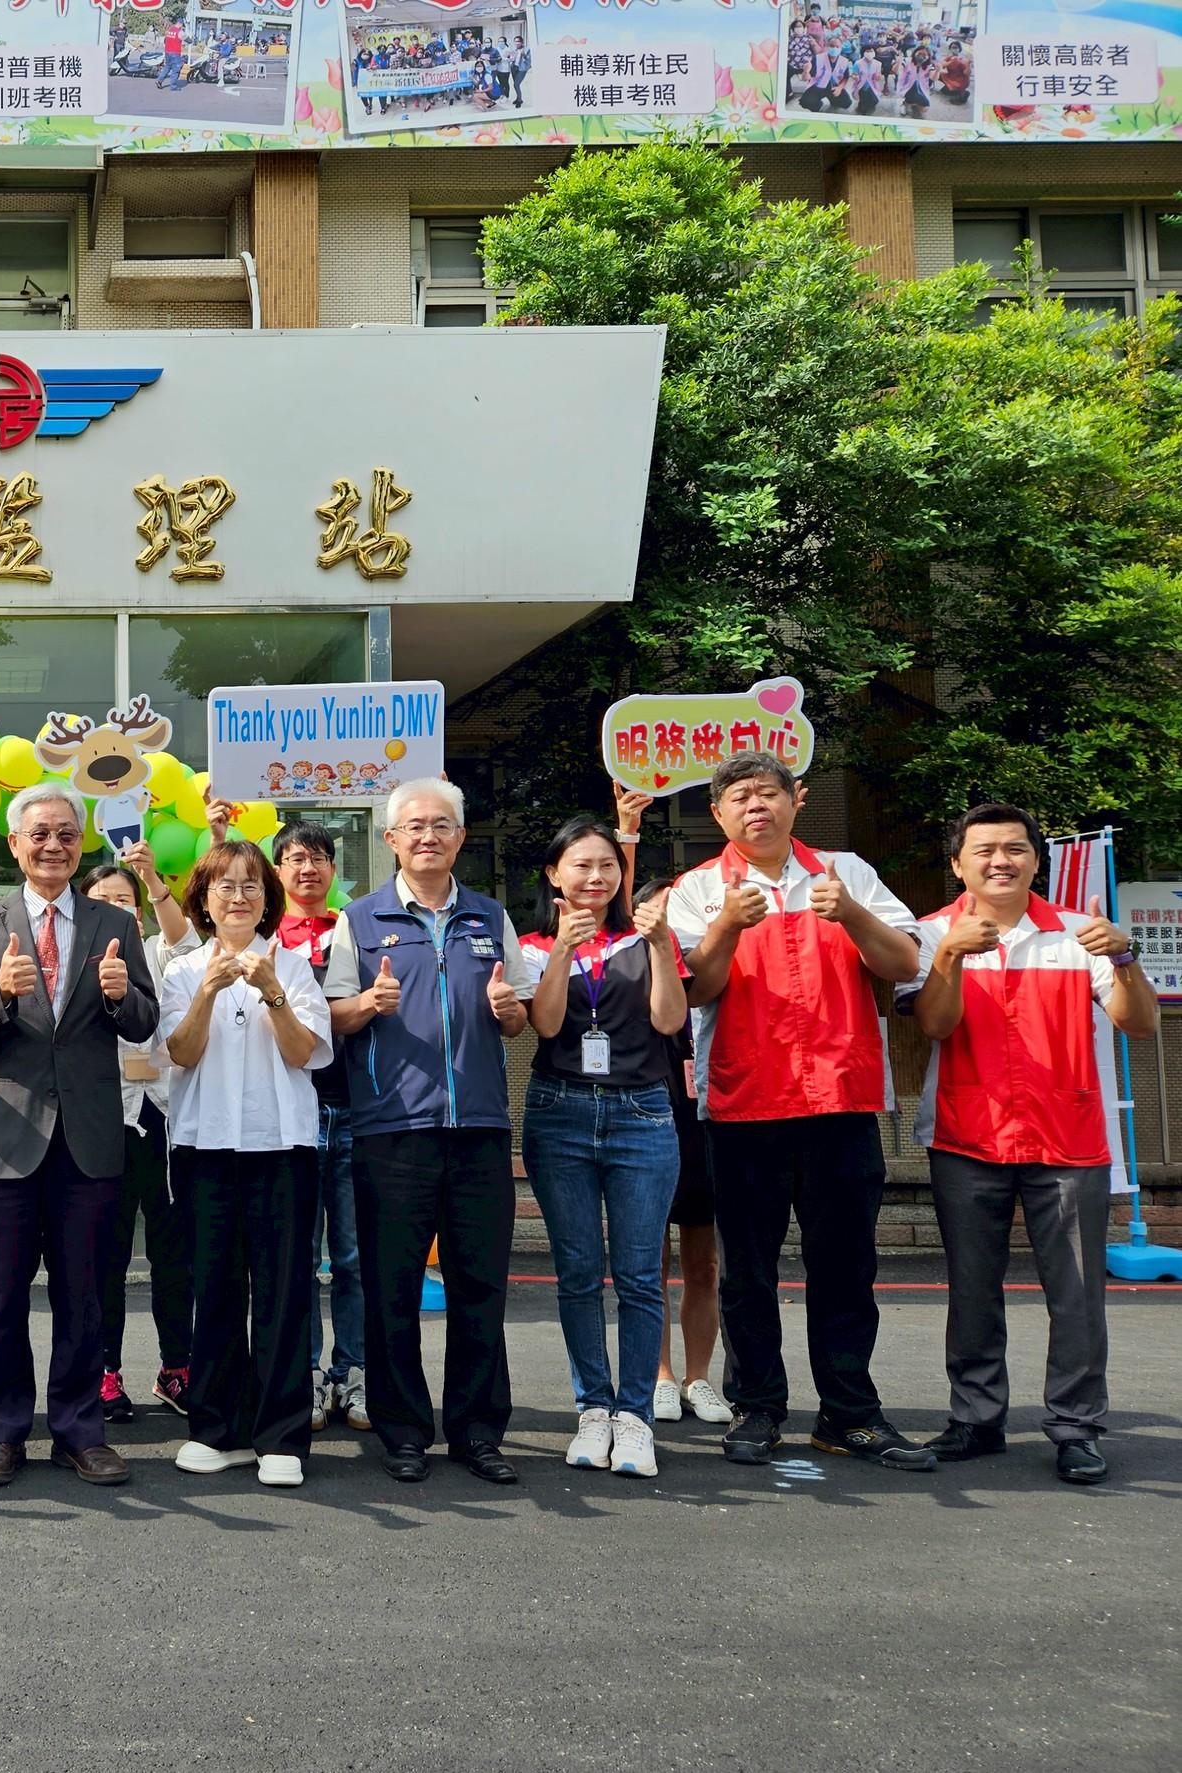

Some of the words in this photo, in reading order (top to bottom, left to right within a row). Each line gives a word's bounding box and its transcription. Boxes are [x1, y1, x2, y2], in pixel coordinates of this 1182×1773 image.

[559, 53, 690, 77] 輔導新住民
[1002, 44, 1131, 67] 關懷高齡者
[574, 83, 678, 107] 機車考照
[1016, 74, 1120, 97] 行車安全
[214, 698, 276, 743] Thank
[281, 705, 317, 753] you
[322, 695, 386, 740] Yunlin
[392, 693, 439, 738] DMV
